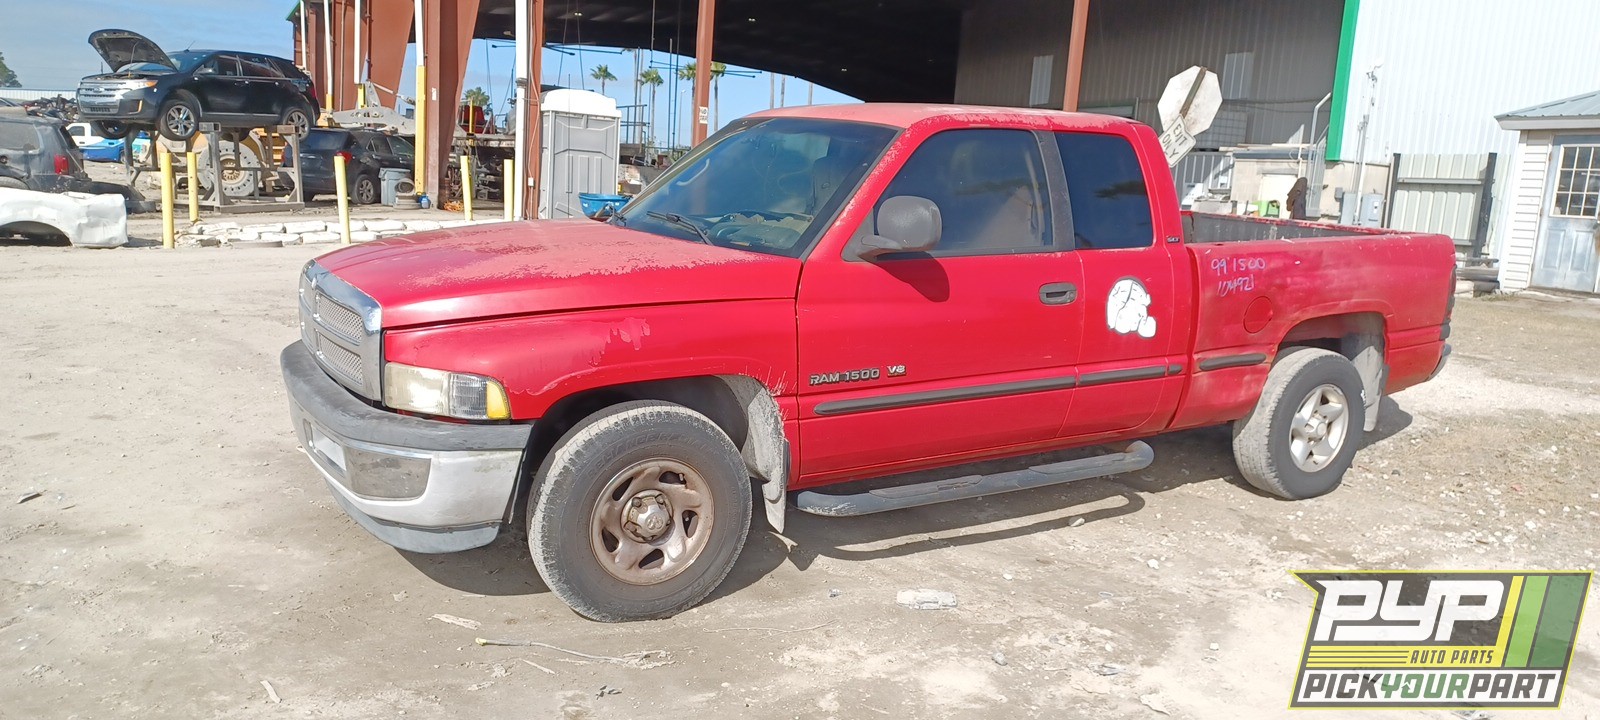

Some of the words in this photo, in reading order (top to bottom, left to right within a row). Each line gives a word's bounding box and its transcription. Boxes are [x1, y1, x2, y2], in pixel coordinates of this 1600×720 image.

[1233, 257, 1266, 273] 1500
[809, 372, 840, 386] RAM
[844, 367, 880, 381] 1500
[886, 364, 906, 375] V8
